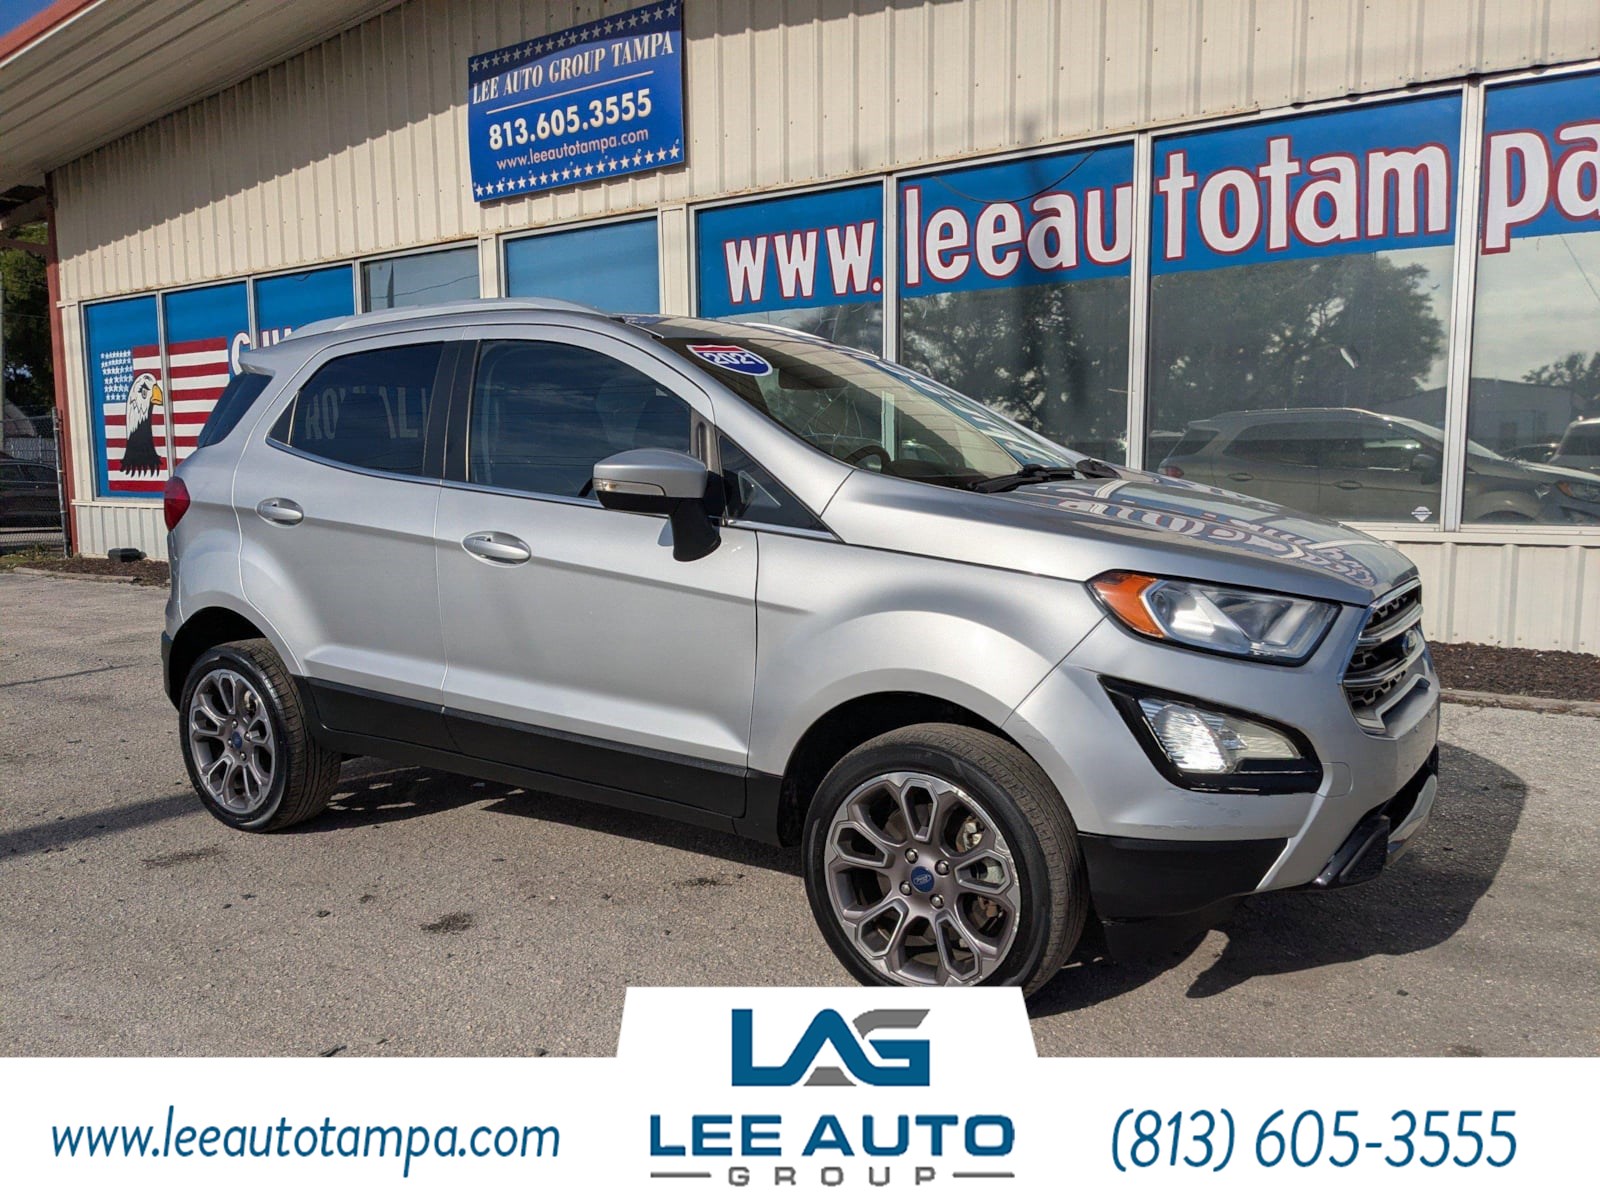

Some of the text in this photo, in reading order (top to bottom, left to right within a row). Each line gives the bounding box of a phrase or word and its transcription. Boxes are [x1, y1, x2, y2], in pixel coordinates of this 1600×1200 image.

[472, 30, 674, 105] LEE AUTO GROUP TAMPA
[488, 88, 653, 151] 813.605.3555
[496, 128, 649, 171] www.leeautotampa.com
[702, 351, 765, 366] 2021
